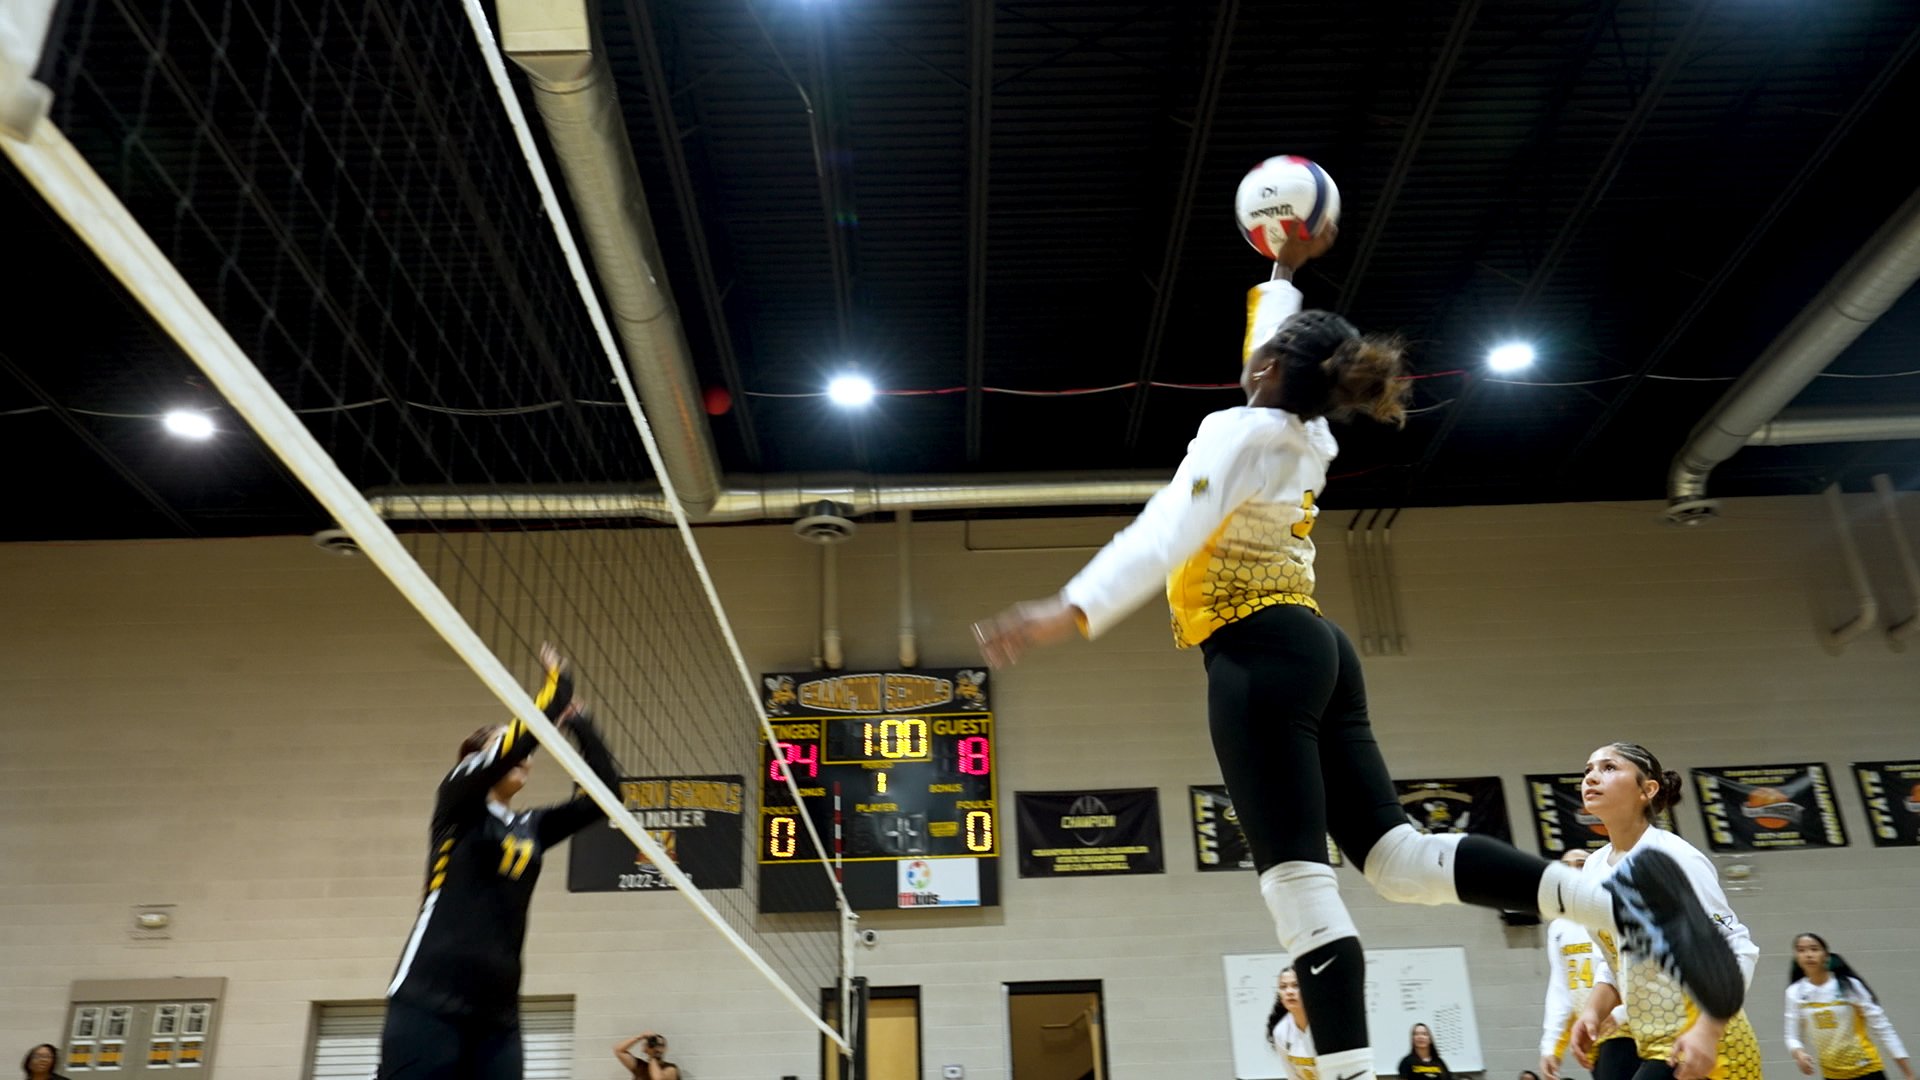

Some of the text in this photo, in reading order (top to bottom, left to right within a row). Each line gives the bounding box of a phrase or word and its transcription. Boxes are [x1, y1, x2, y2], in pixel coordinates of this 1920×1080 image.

[932, 719, 990, 735] GUEST
[769, 742, 818, 781] 24
[958, 737, 990, 775] 18
[797, 787, 826, 797] ONUS
[877, 772, 887, 793] 1
[928, 783, 963, 793] BONUS
[855, 802, 898, 812] PLAYER
[956, 800, 992, 809] FOULS
[1532, 782, 1564, 851] STATE
[1698, 775, 1734, 844] STATE
[1859, 769, 1898, 839] STATE
[608, 811, 706, 830] ANDLER
[966, 811, 992, 852] 0
[1195, 794, 1219, 864] STATE
[770, 817, 796, 858] 0
[619, 871, 693, 888] 2022-2
[1568, 958, 1594, 989] 24
